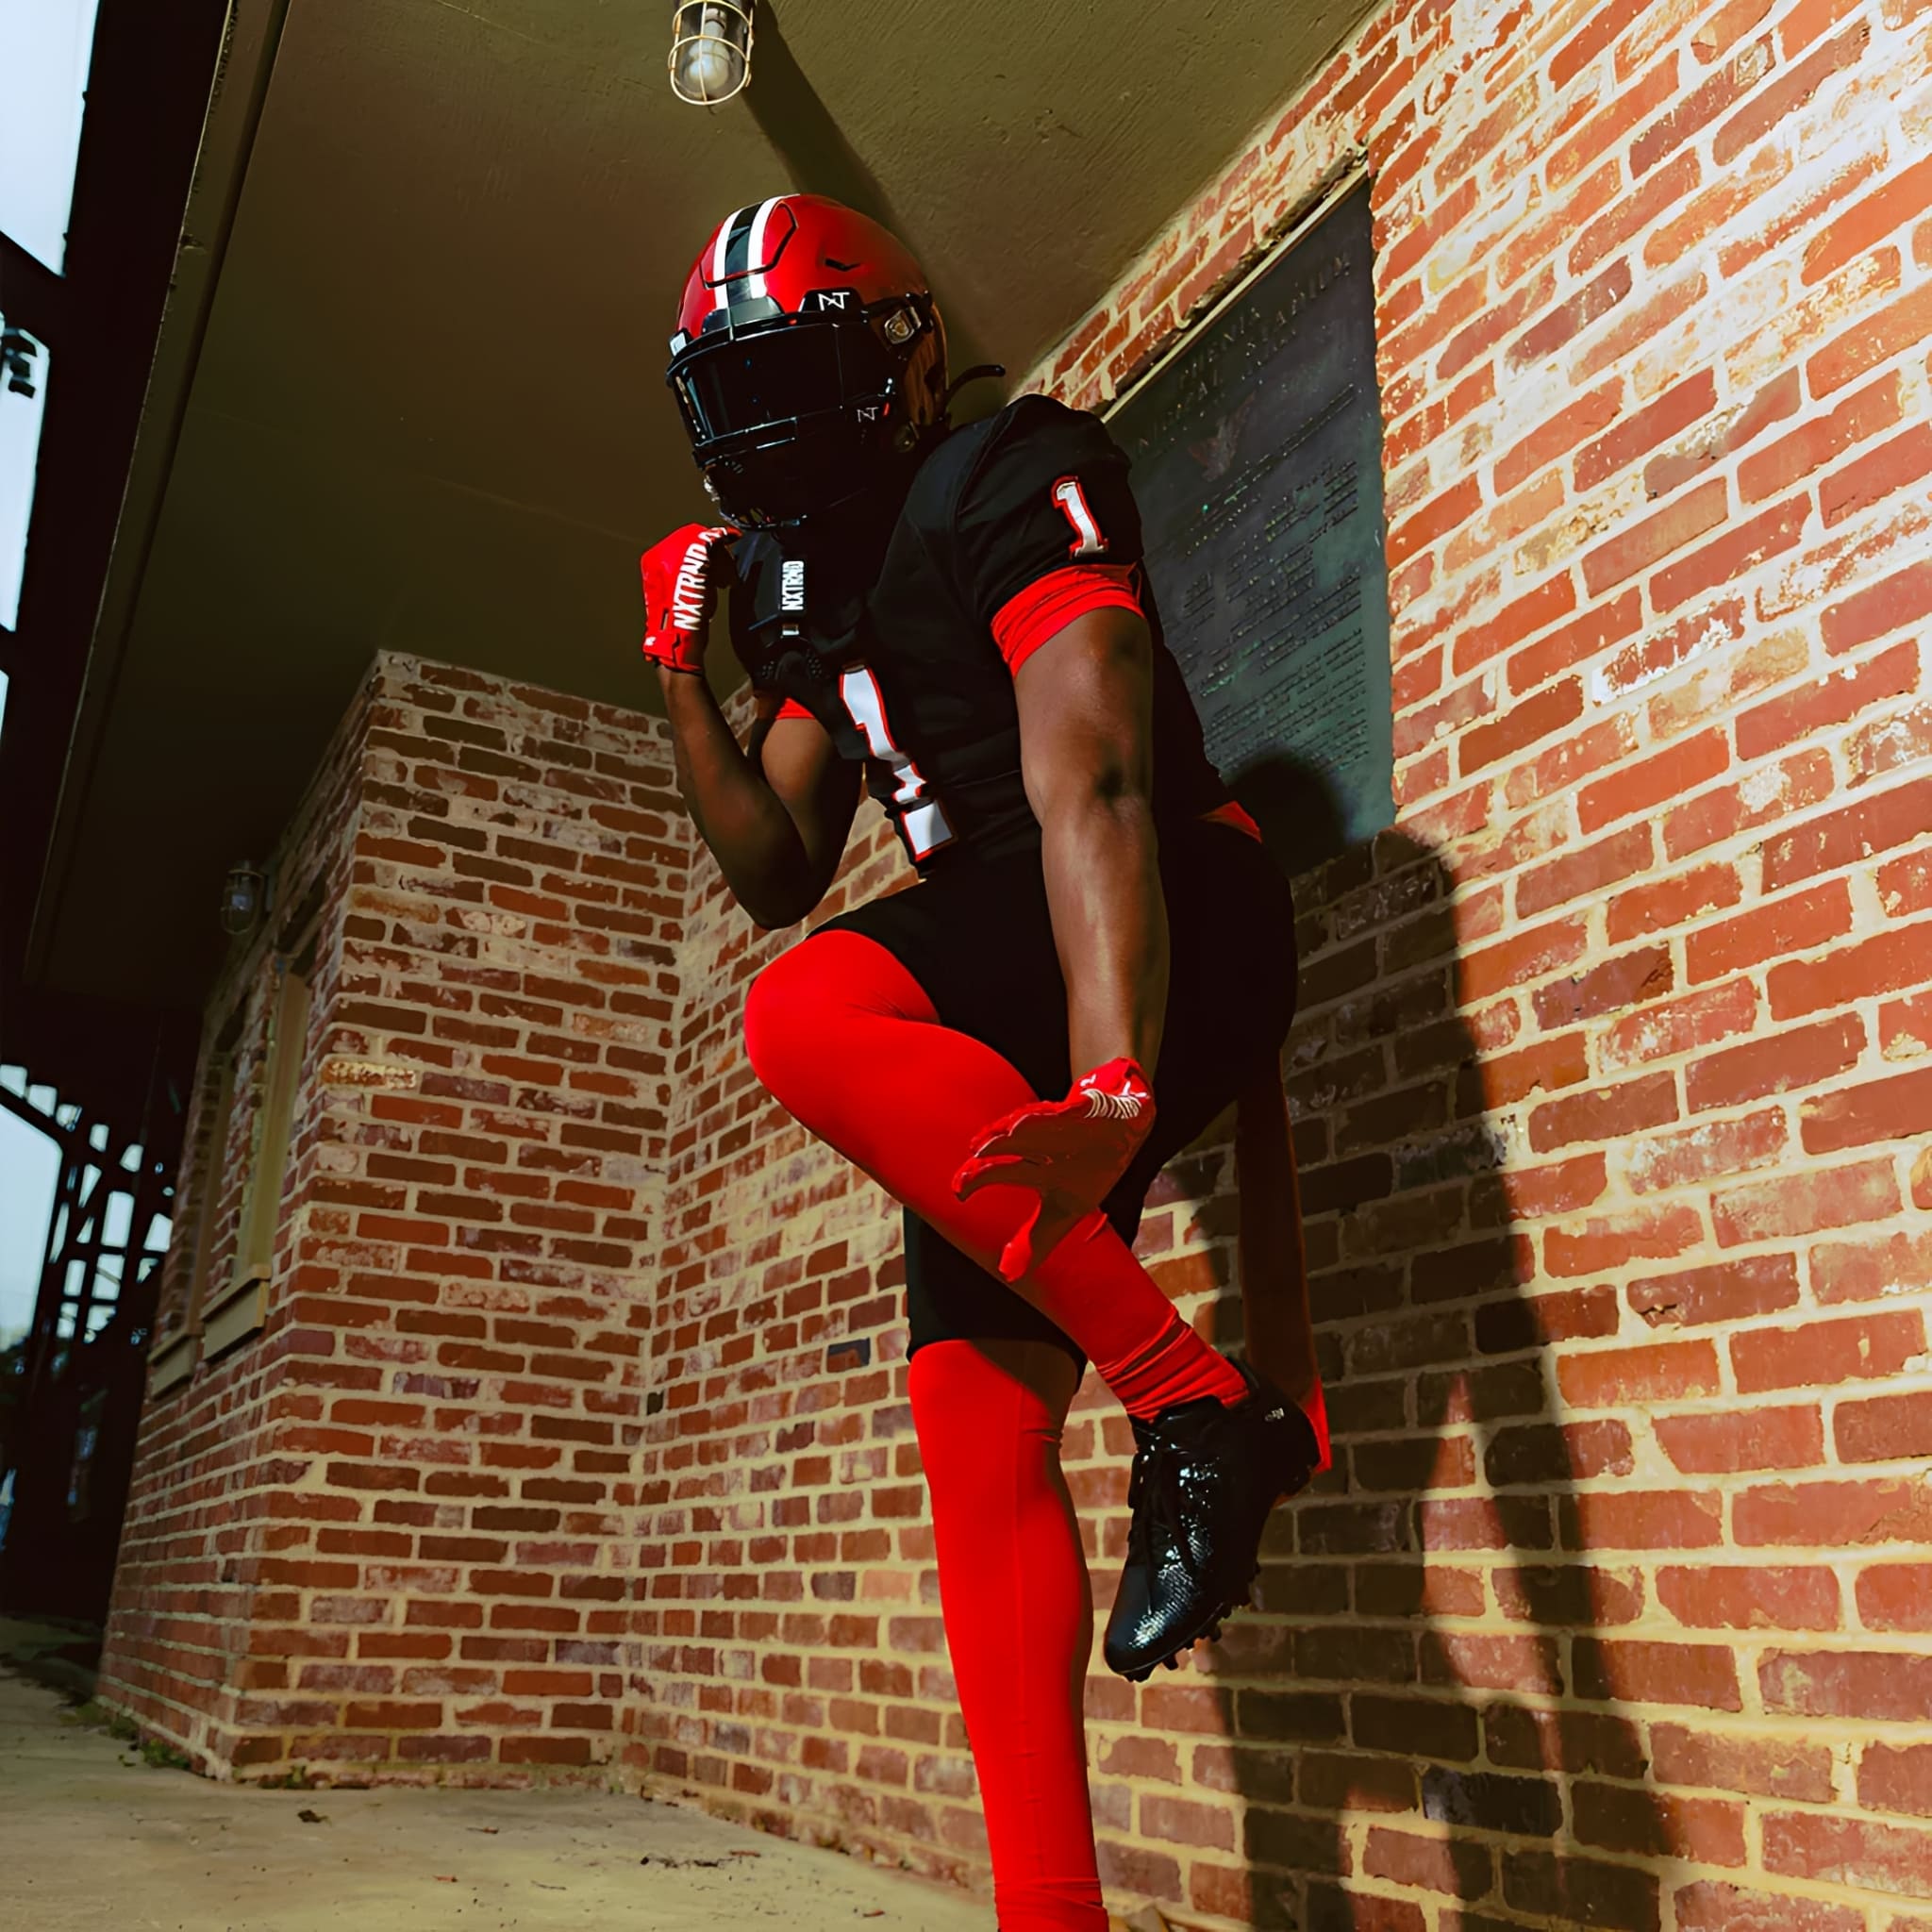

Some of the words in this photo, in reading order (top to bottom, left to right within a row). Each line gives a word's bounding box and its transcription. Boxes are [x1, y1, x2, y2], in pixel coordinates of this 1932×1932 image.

[1051, 475, 1109, 560] 1
[673, 541, 709, 631] NXTRND
[782, 560, 804, 610] NXTRND
[839, 664, 958, 862] 1
